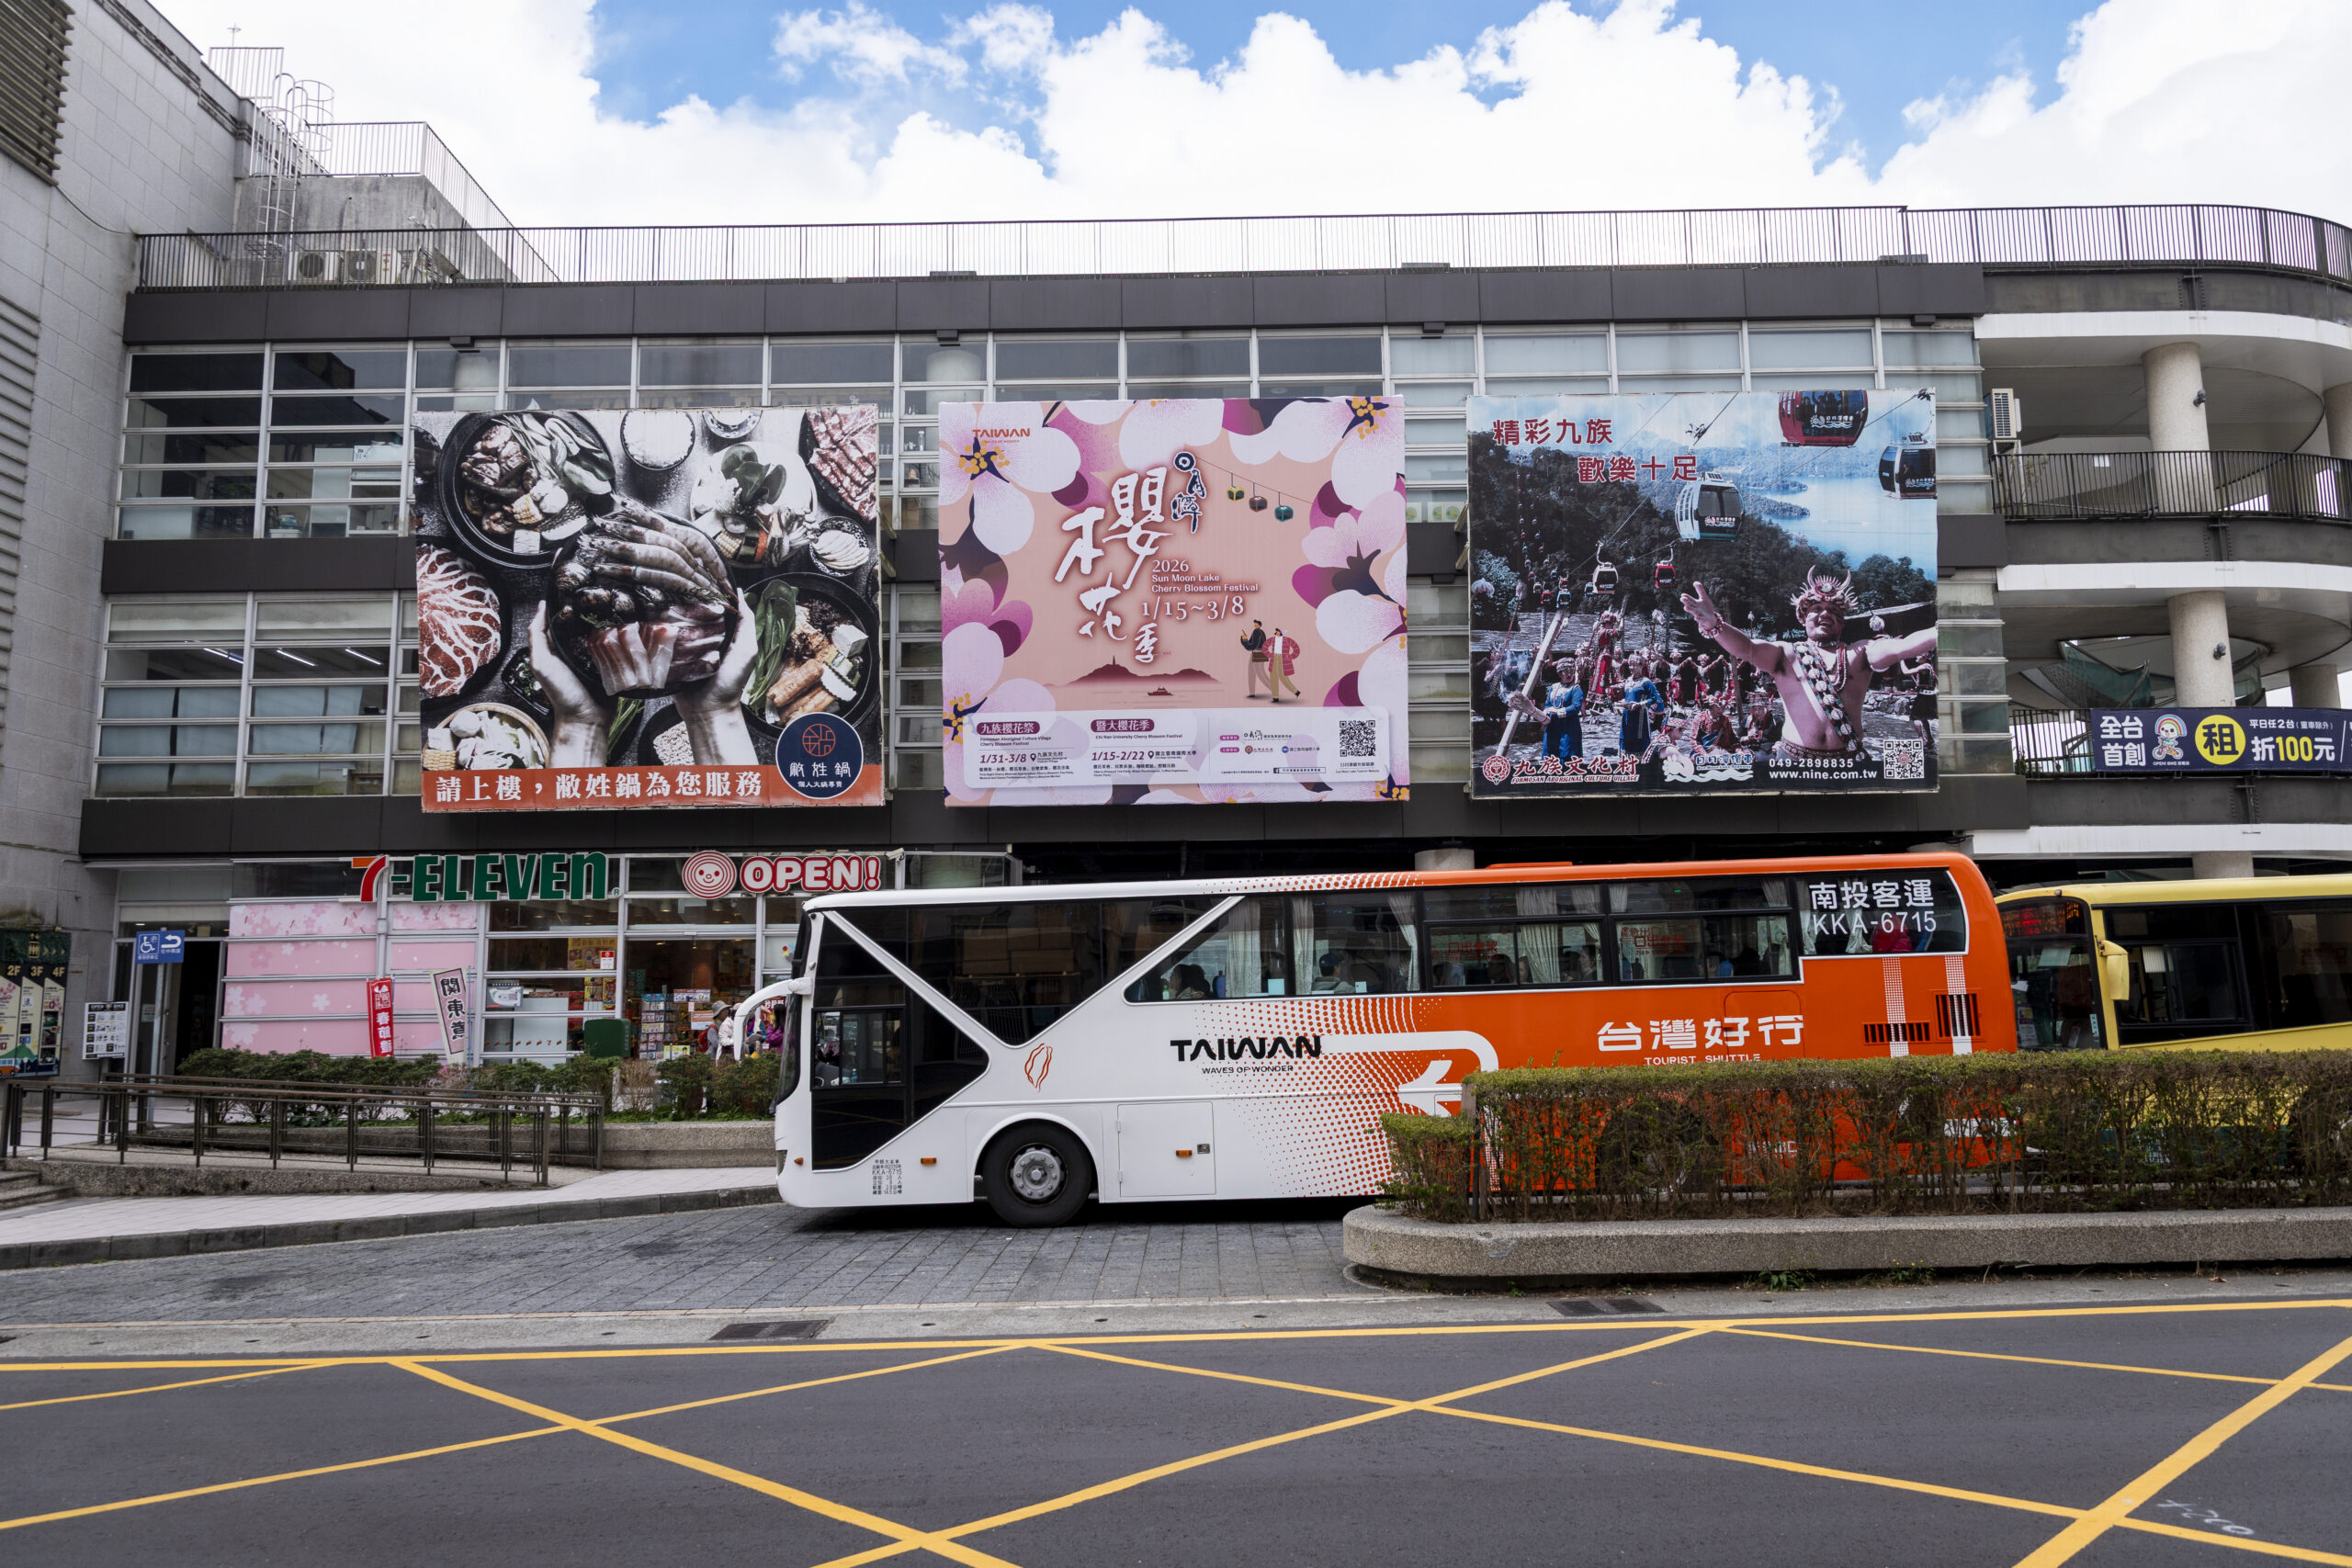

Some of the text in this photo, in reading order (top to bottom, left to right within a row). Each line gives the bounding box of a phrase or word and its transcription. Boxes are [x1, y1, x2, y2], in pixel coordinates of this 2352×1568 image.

[972, 428, 1030, 438] TAIWAN
[1492, 418, 1613, 446] 精彩九族
[1577, 456, 1698, 483] 歡樂十足
[1152, 559, 1189, 572] 2026
[1152, 573, 1220, 582] Sun Moon Lake
[1151, 583, 1259, 593] Cherry Blossom Festival
[1141, 595, 1244, 621] 1/15~3/8
[981, 722, 1035, 734] 九族櫻花祭
[1096, 720, 1150, 731] 暨大櫻花季
[2099, 716, 2143, 739] 全台
[2202, 723, 2240, 757] 租
[2101, 742, 2146, 767] 首創
[2251, 736, 2335, 761] 折100元
[980, 753, 1027, 764] 1/31-3/8
[1091, 750, 1145, 761] 1/15-2/22
[789, 761, 852, 778] 敝姓鍋
[1513, 754, 1640, 776] 九族文化村
[1769, 759, 1854, 768] 049-2898835
[1511, 775, 1545, 784] FORMOSAN
[1584, 774, 1613, 783] CULTURE
[1770, 770, 1877, 780] www.nine.com.tw
[740, 855, 881, 894] OPEN!
[1808, 879, 1935, 910] 南投客運
[1812, 910, 1937, 935] KKA-6715
[7, 965, 21, 976] 2F
[30, 966, 43, 976] 3F
[52, 966, 65, 977] 4F
[1597, 1014, 1804, 1052] 台灣好行
[1170, 1035, 1321, 1062] TAIWAN
[1645, 1055, 1696, 1066] TOURIST
